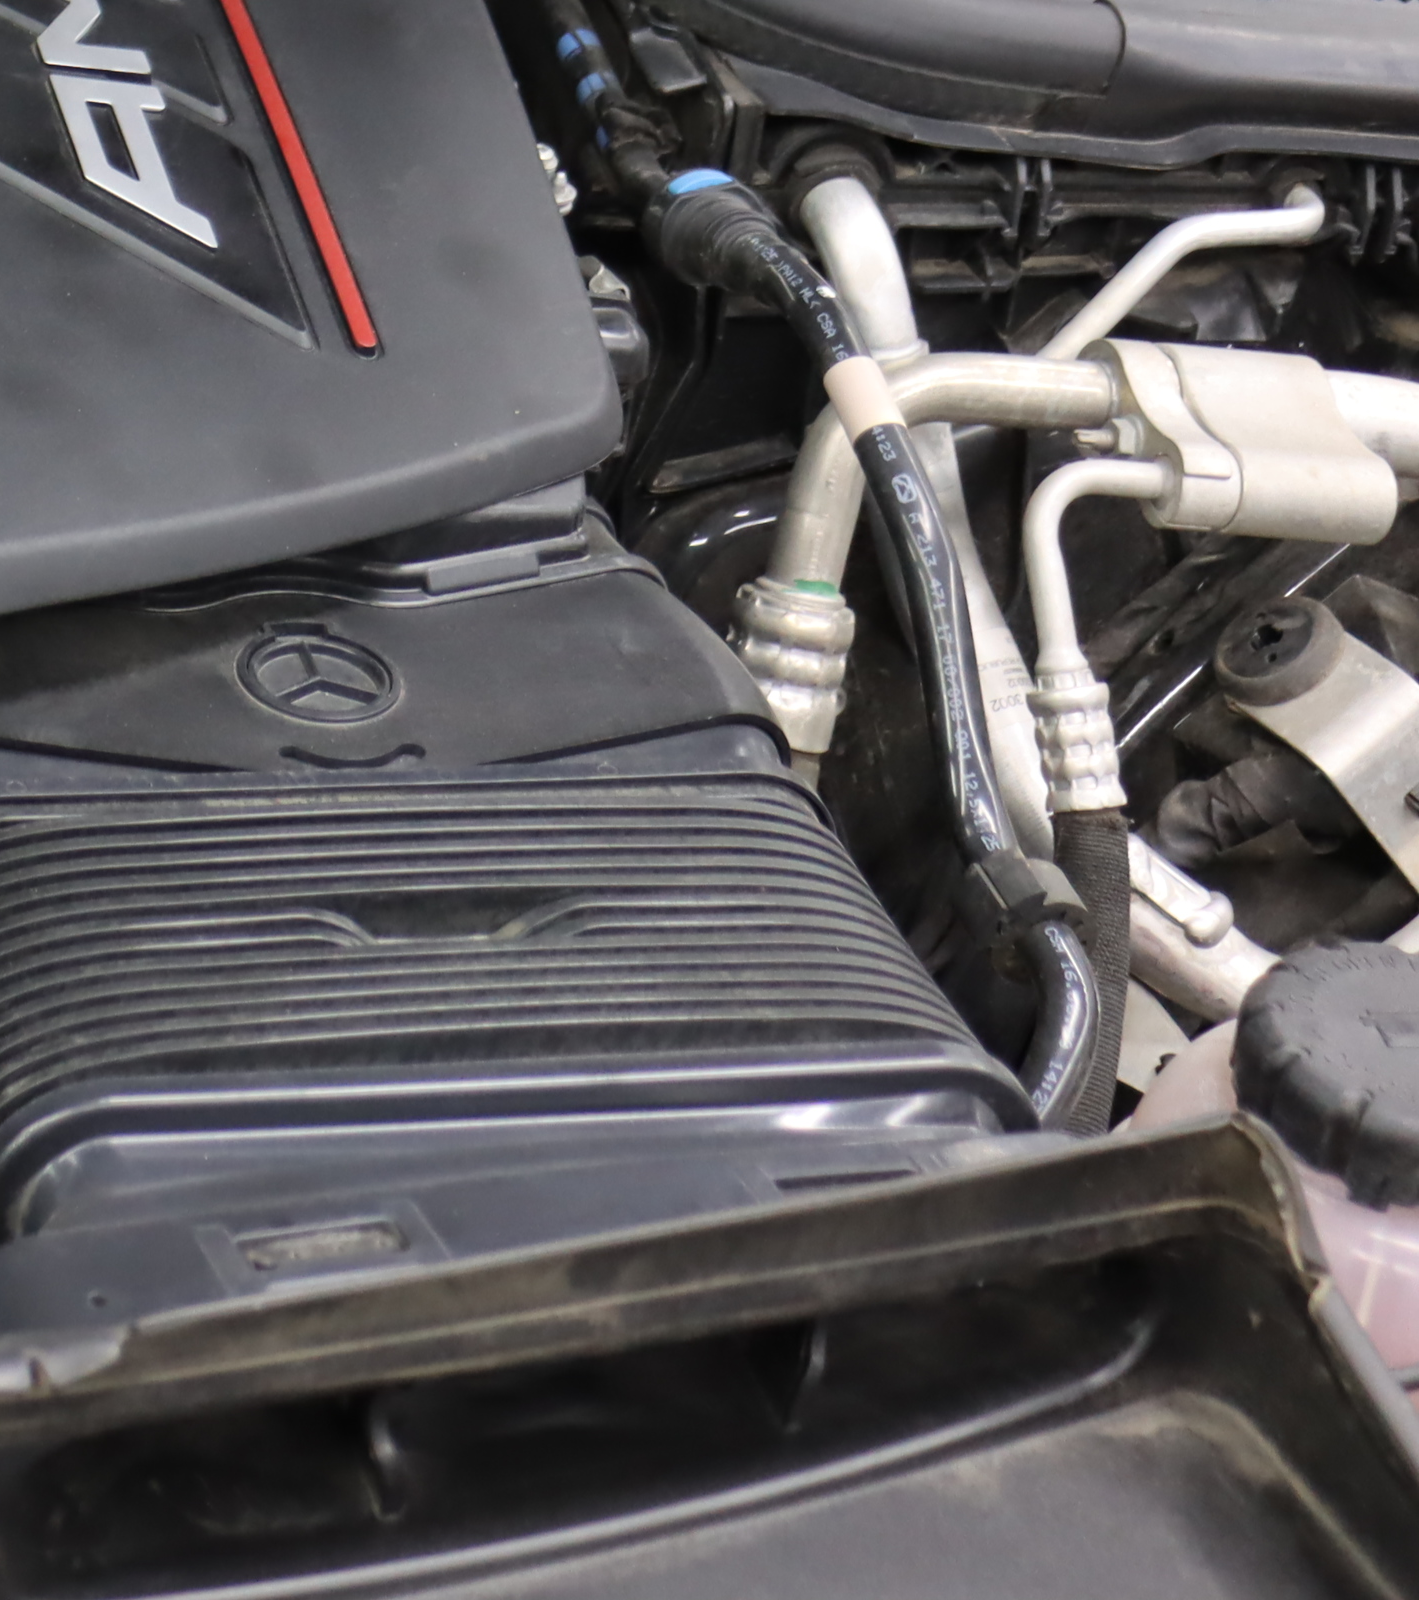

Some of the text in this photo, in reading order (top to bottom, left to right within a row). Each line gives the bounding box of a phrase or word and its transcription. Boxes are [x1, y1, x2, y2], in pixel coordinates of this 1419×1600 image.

[816, 312, 837, 339] CSA
[916, 533, 938, 567] 213
[929, 577, 946, 611] 471
[937, 624, 953, 644] 17
[989, 693, 1024, 712] 3002
